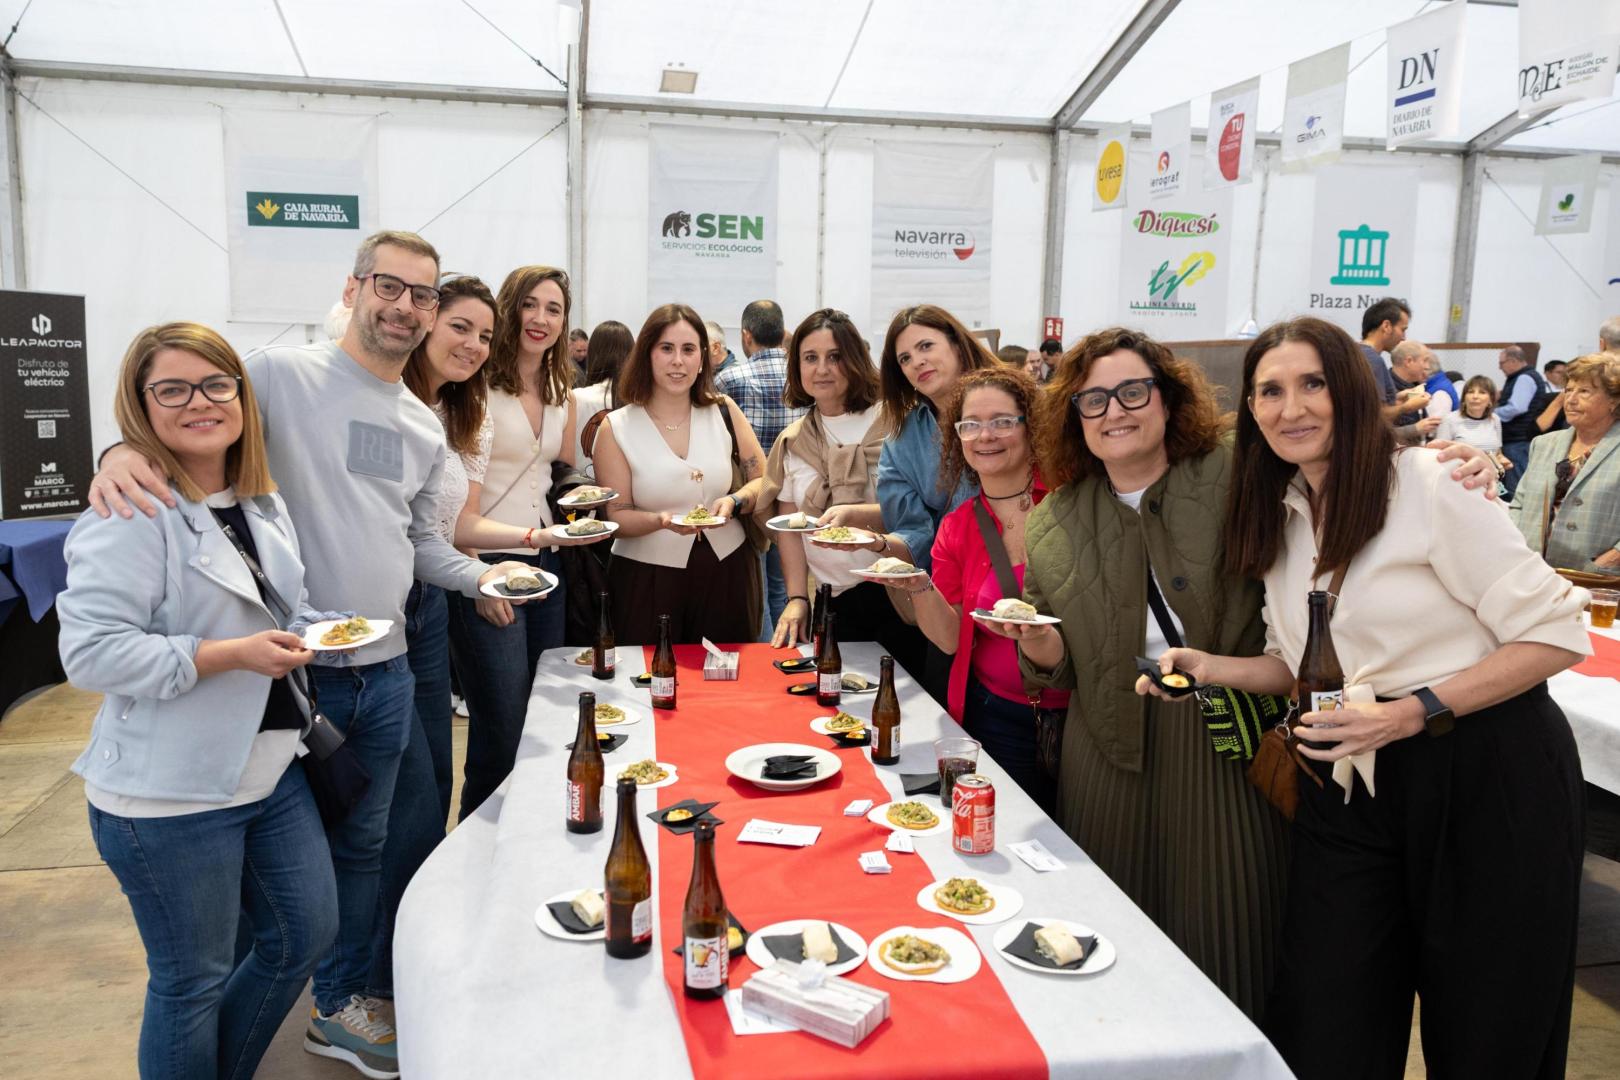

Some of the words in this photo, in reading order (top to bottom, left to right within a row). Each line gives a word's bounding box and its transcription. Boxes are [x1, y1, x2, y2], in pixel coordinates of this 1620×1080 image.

[1595, 56, 1608, 65] DE
[1397, 48, 1440, 90] DN
[1393, 109, 1420, 124] DIARIO
[1421, 105, 1432, 117] DE
[1232, 117, 1243, 133] TU
[1393, 119, 1431, 136] NAVARRA
[284, 203, 308, 212] CAJA
[310, 204, 344, 214] RURAL
[284, 212, 299, 221] DE
[301, 213, 349, 223] NAVARRA
[696, 213, 764, 241] SEN
[895, 230, 966, 246] Navarra
[662, 242, 706, 251] SERVICIOS
[708, 243, 764, 254] ECOLÓGICOS
[895, 248, 947, 260] televisión
[1310, 293, 1353, 309] Plaza
[0, 338, 82, 348] LEAPMOTOR
[57, 360, 69, 369] de
[17, 369, 29, 377] tu
[30, 368, 70, 377] vehículo
[24, 378, 65, 387] eléctrico
[34, 478, 65, 486] MARCO
[20, 500, 80, 511] www.marco.es
[572, 784, 581, 821] AMBAR
